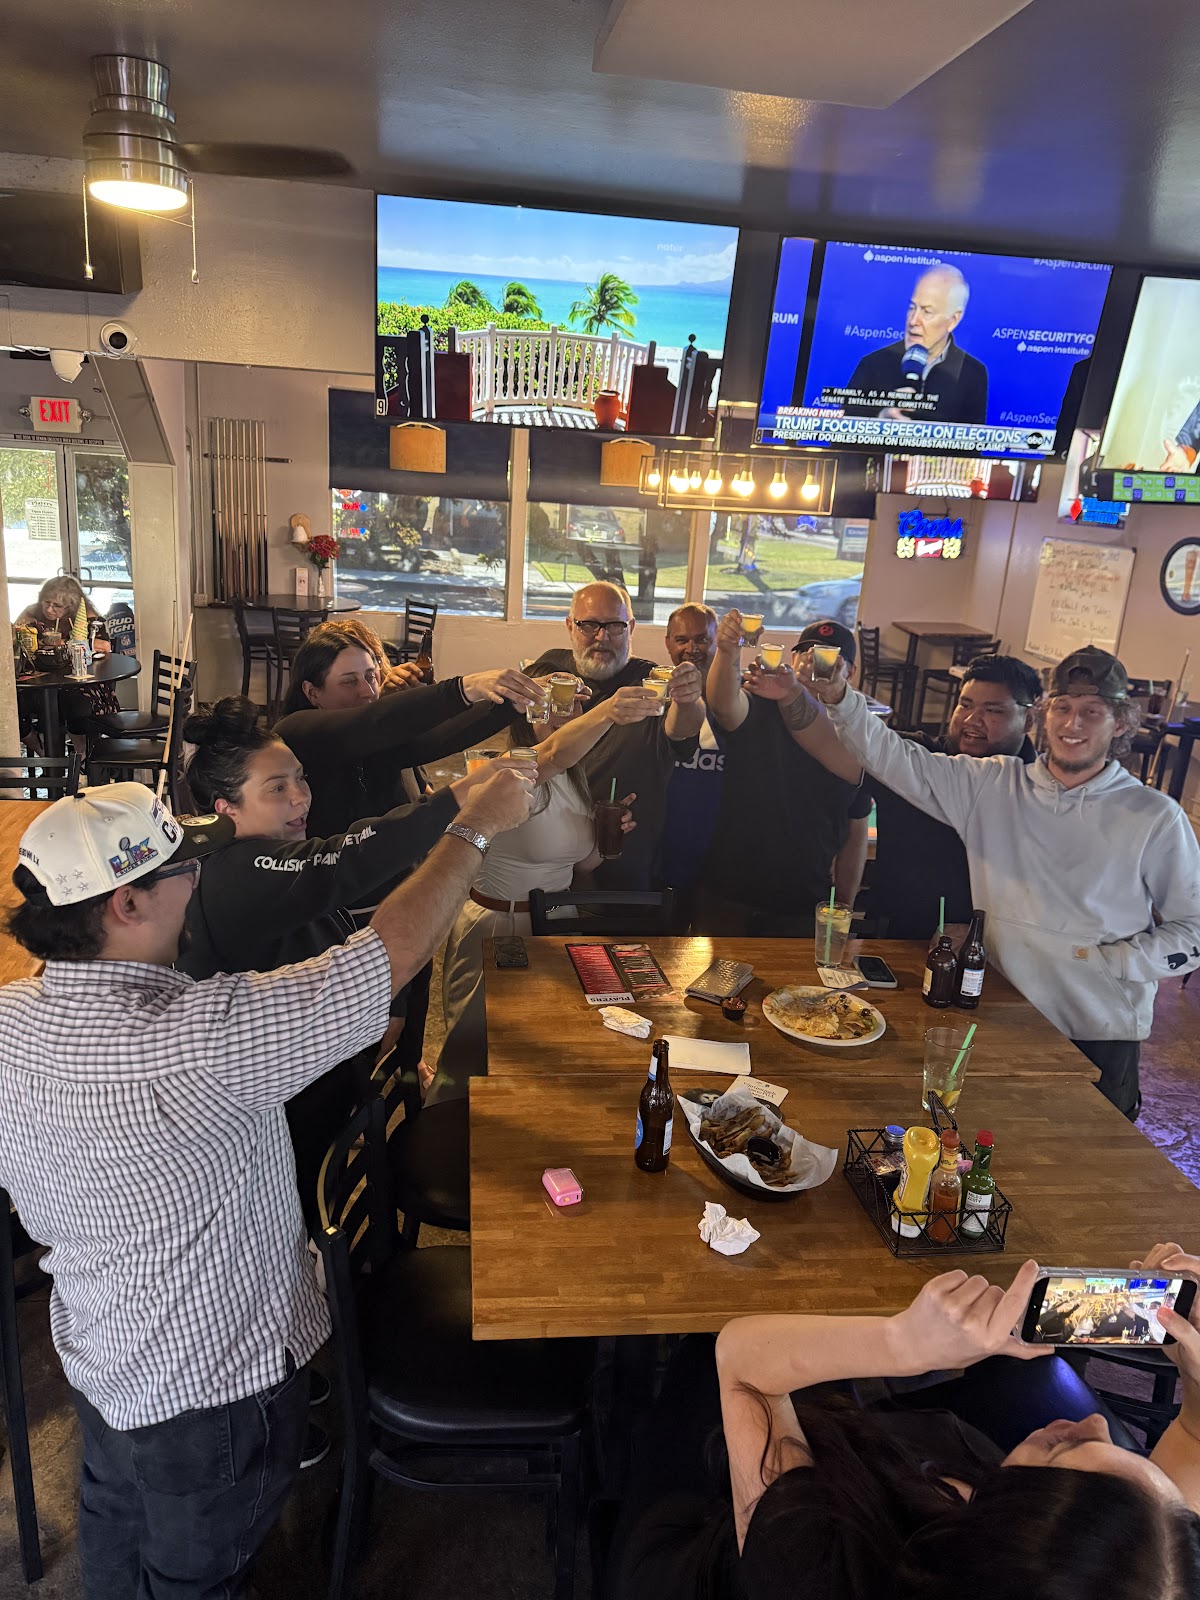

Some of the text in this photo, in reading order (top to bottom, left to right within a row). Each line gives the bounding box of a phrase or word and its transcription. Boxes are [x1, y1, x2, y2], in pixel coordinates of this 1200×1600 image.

[874, 254, 942, 266] aspen institute
[772, 312, 799, 325] RUM
[992, 327, 1096, 345] ASPENSECURITYFO
[1026, 344, 1090, 356] aspen institute
[820, 395, 845, 404] SENATE
[848, 397, 895, 407] INTELLIGENCE
[833, 387, 865, 397] FRANKLY,
[868, 389, 878, 398] AS
[880, 390, 886, 398] A
[888, 391, 913, 400] MEMBER
[914, 393, 924, 401] OF
[926, 393, 940, 402] THE
[39, 399, 70, 423] EXIT
[378, 400, 384, 414] 9
[777, 405, 844, 419] BREAKING NEWS
[1000, 411, 1057, 425] #AspenSec
[775, 415, 1021, 443] TRUMP FOCUSES SPEECH ON ELECTIONS
[772, 429, 818, 441] PRESIDENT
[818, 433, 857, 444] DOUBLES
[857, 435, 885, 446] DOWN
[885, 438, 900, 447] ON
[900, 438, 975, 451] UNSUBSTANTIATED
[975, 443, 1006, 453] CLAIMS
[1027, 435, 1043, 445] abc
[898, 509, 964, 539] Coors
[109, 617, 132, 628] BUD
[110, 624, 134, 635] IGHT
[253, 850, 342, 872] COLLISI PAIN
[590, 995, 631, 1003] PLAYERS
